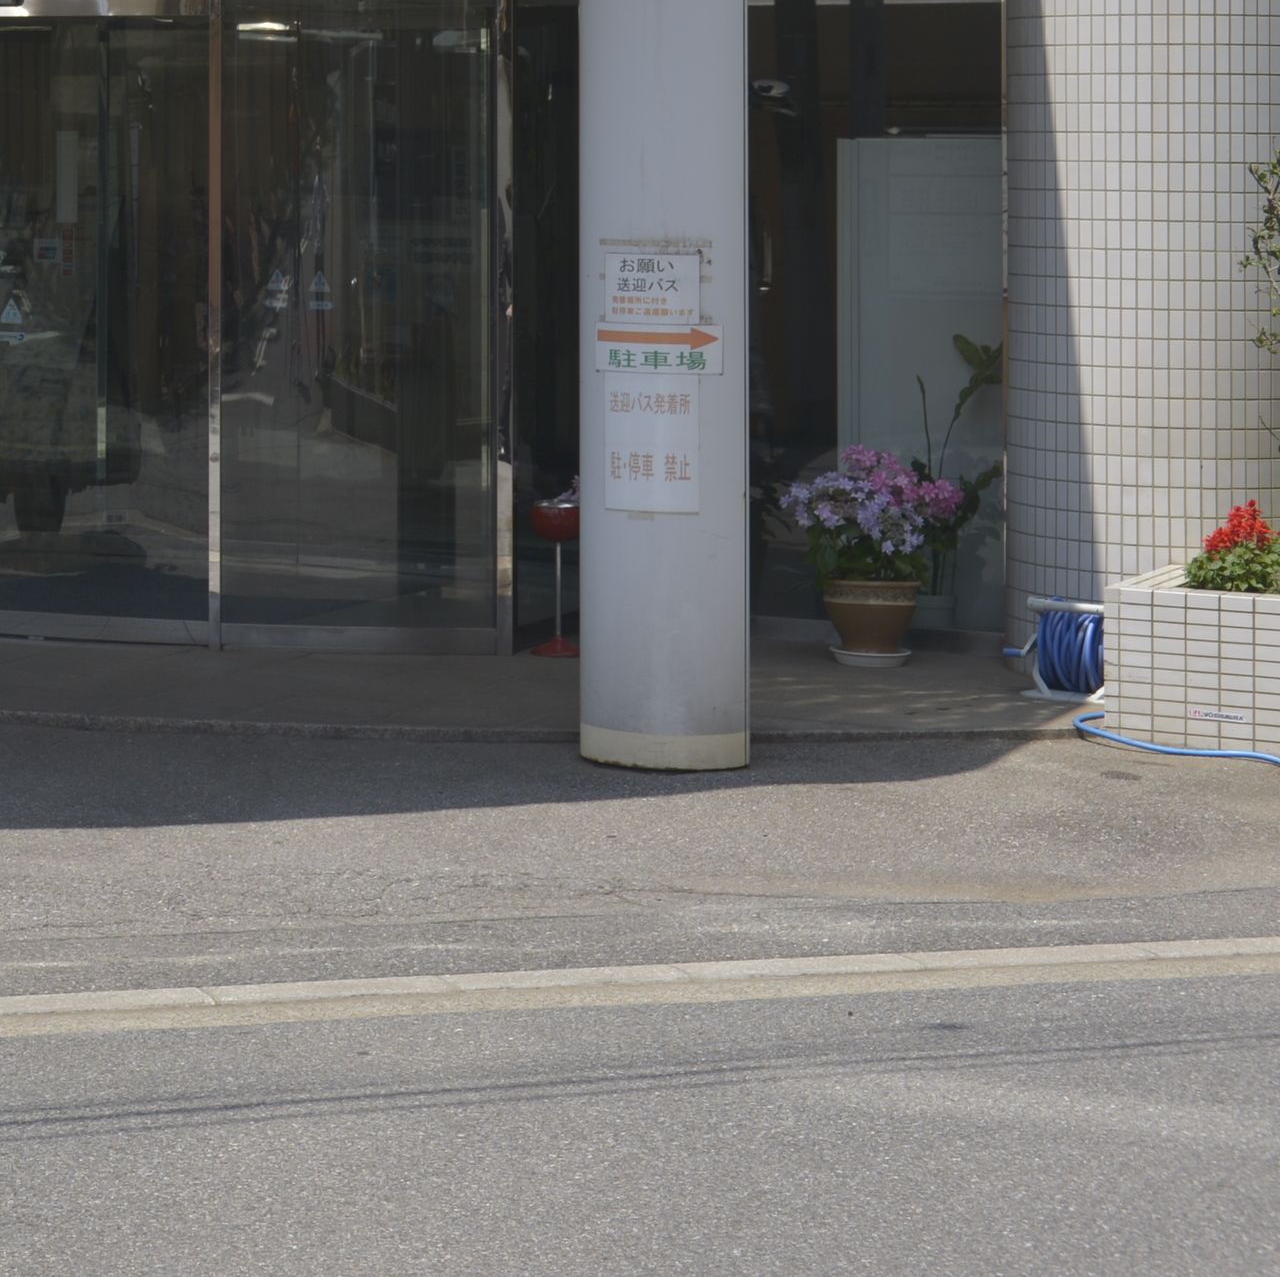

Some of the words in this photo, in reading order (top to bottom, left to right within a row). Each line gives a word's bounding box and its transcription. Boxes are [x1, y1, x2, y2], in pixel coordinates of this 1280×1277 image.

[619, 257, 675, 273] お願い
[617, 277, 679, 293] 送迎バス
[608, 349, 707, 371] 駐車場
[609, 390, 691, 415] 送迎バス発着所
[664, 452, 692, 482] 禁止
